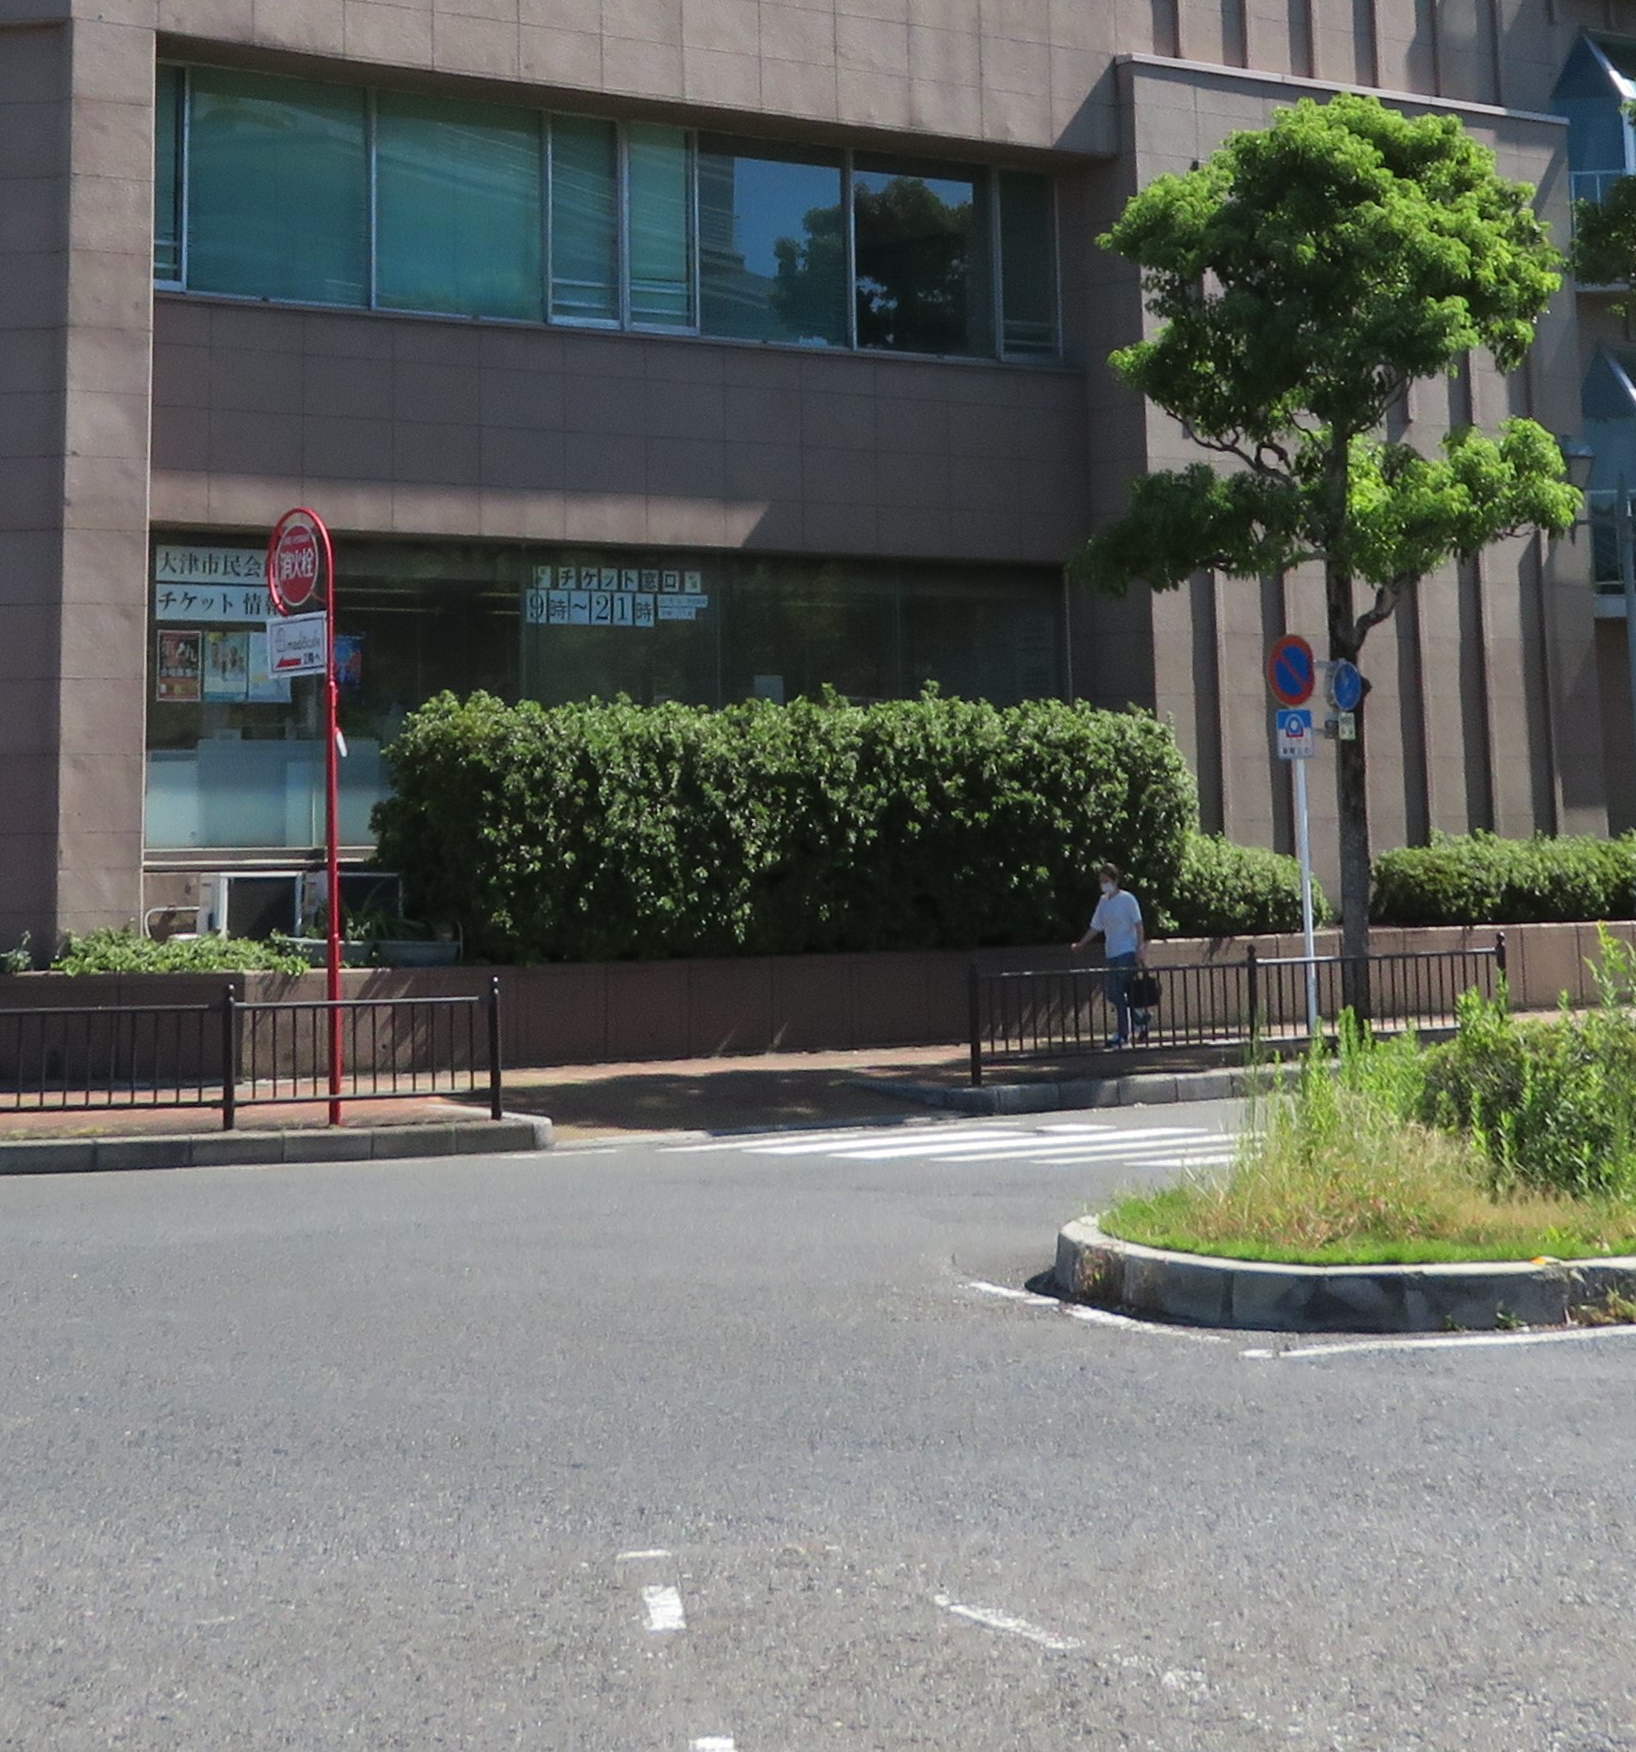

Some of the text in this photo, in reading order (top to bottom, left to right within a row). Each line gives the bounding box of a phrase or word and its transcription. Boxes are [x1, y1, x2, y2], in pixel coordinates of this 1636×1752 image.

[159, 550, 269, 579] 大津市民会
[280, 548, 314, 581] 消火栓
